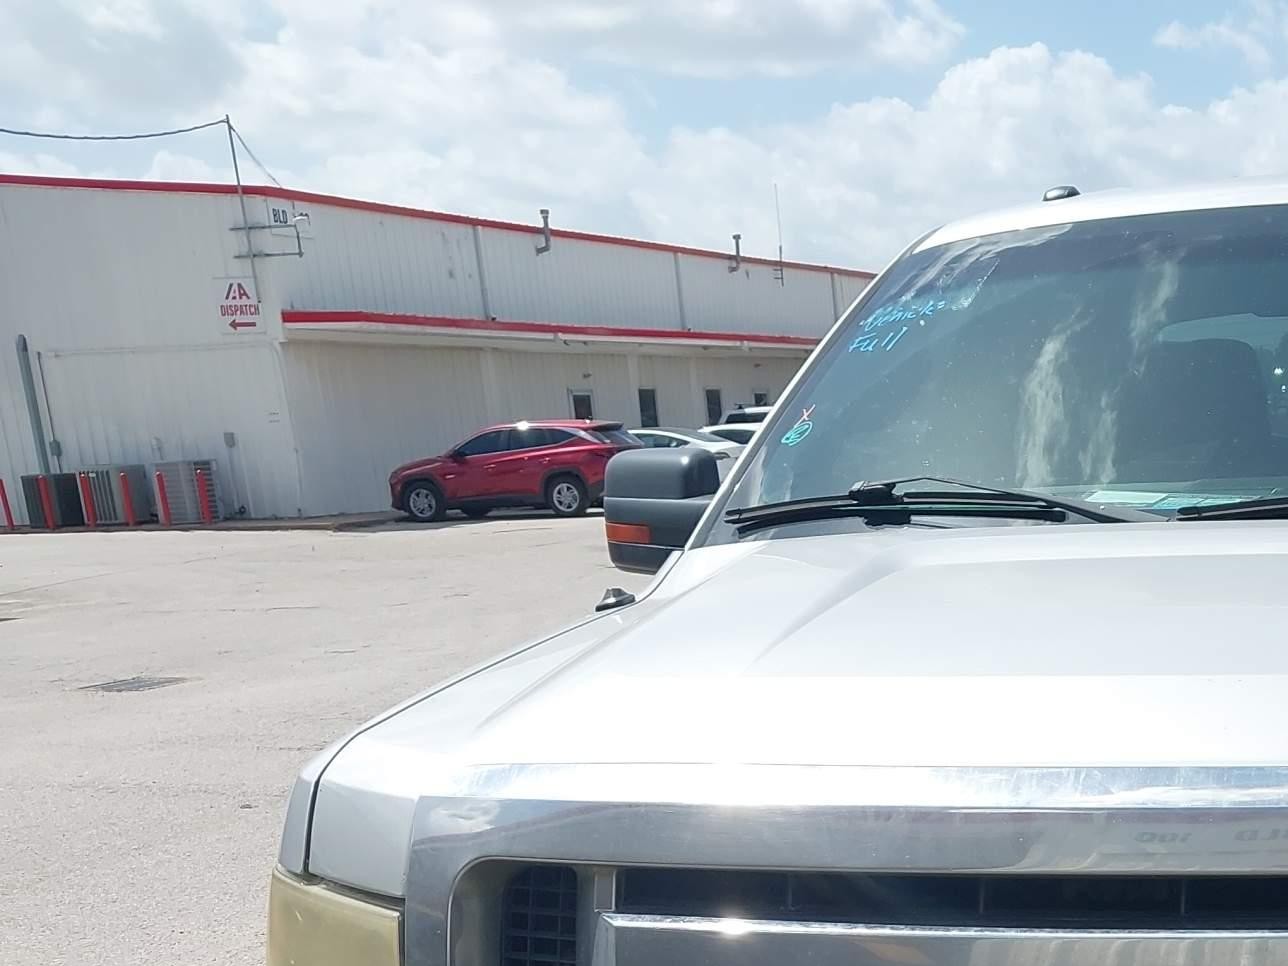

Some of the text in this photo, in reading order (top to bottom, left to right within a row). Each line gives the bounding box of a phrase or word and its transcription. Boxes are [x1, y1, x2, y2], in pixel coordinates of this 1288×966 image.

[271, 207, 289, 225] BLD
[219, 303, 261, 318] DISPATCH
[849, 326, 908, 353] Full
